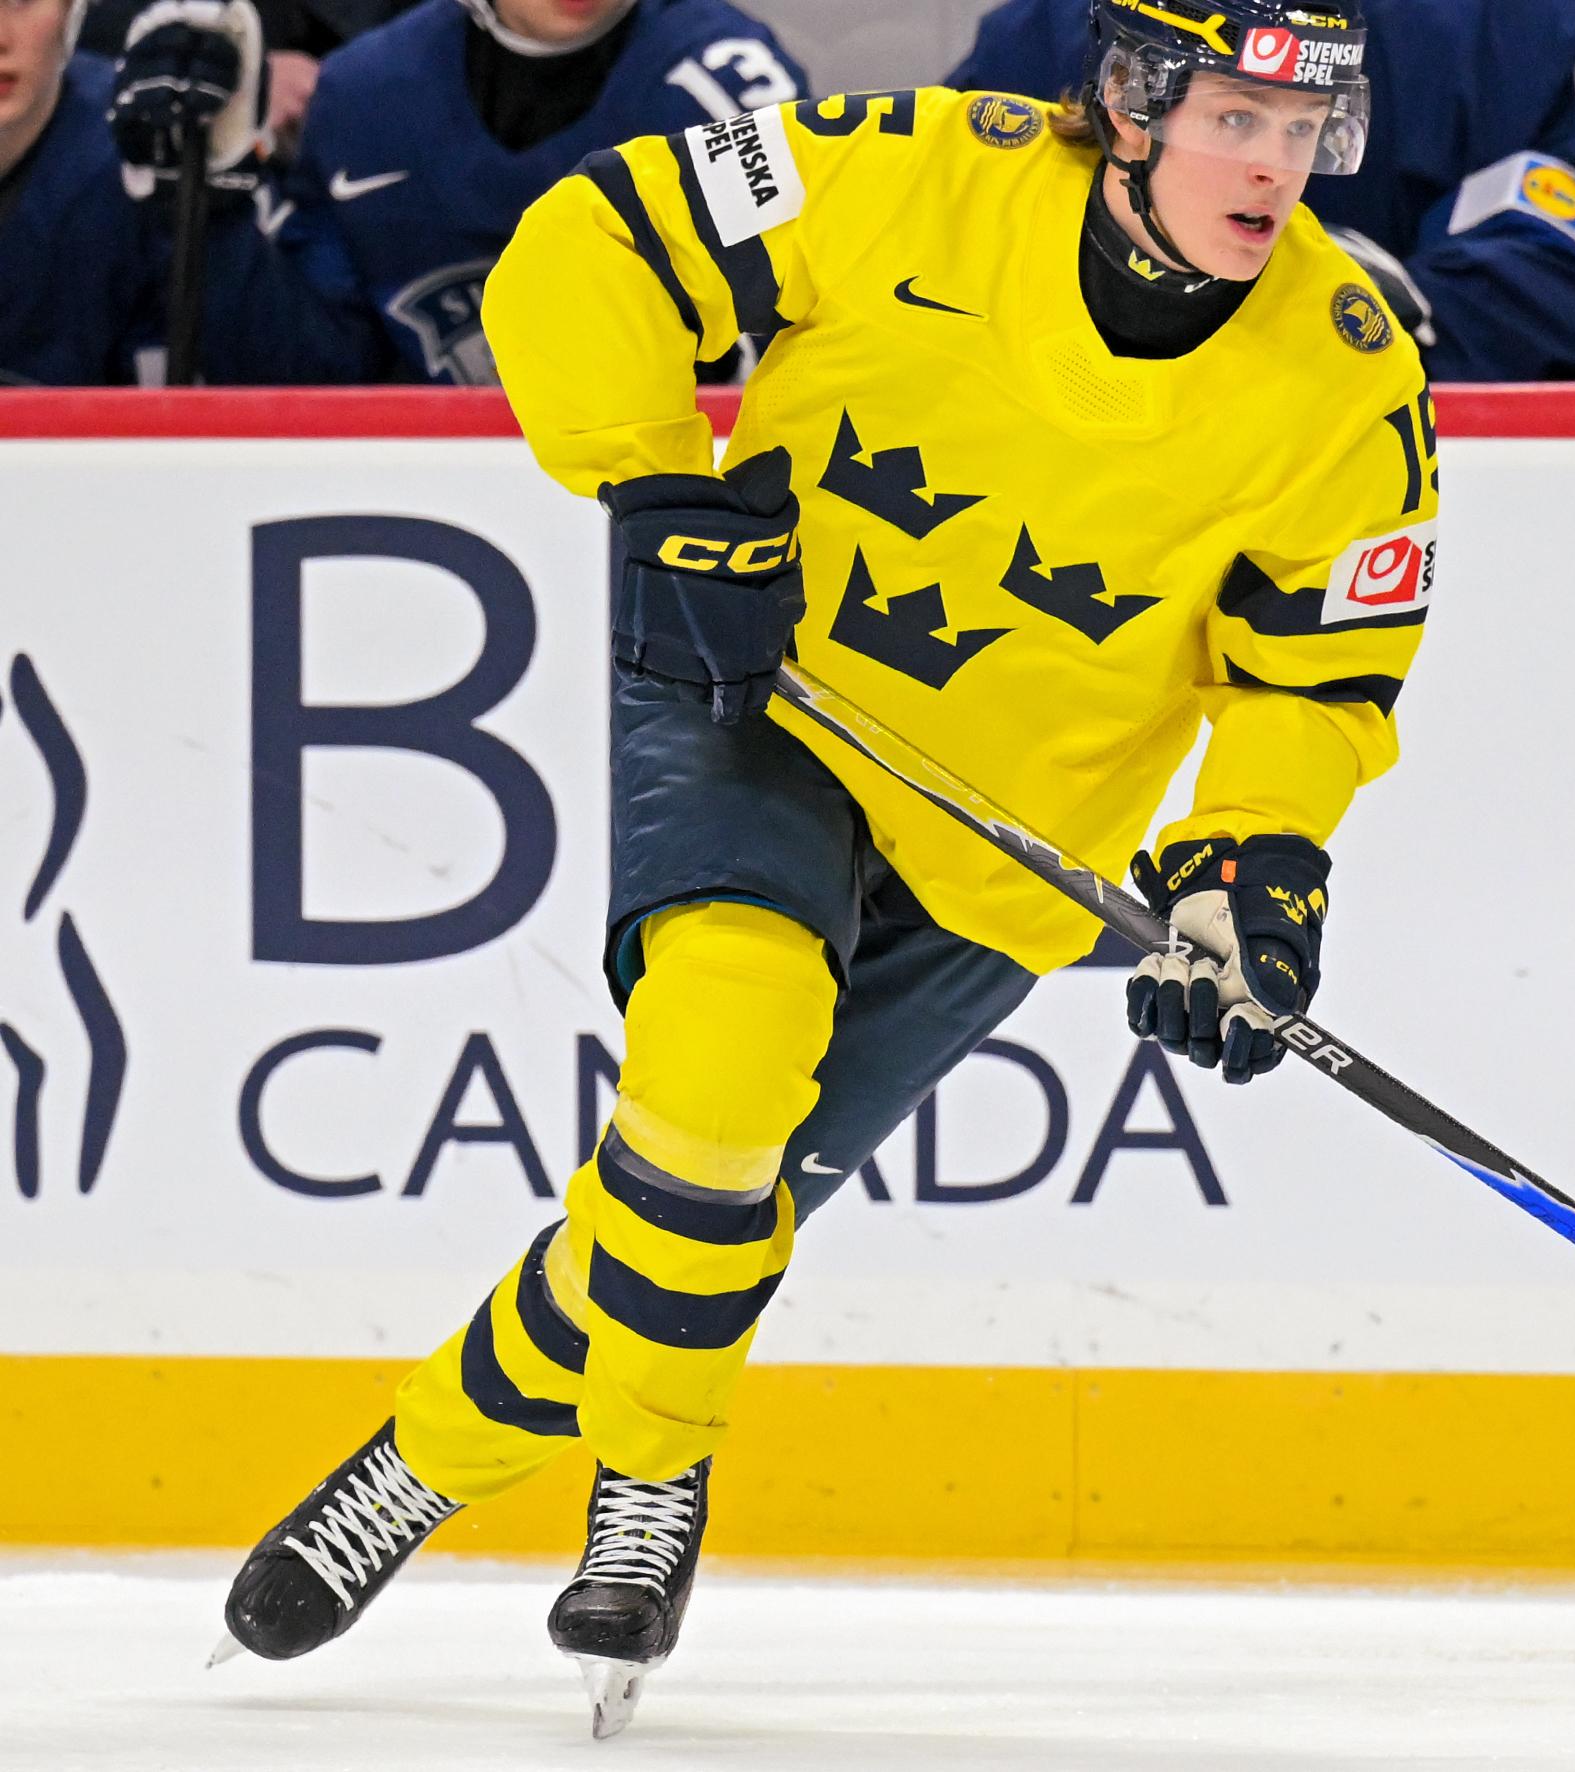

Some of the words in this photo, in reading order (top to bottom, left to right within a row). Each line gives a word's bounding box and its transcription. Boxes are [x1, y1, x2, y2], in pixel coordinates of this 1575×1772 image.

[665, 38, 798, 122] 13
[1292, 61, 1334, 86] SPEL
[702, 121, 733, 163] PEL
[729, 111, 779, 208] VENSKA
[1166, 843, 1213, 891] CCM
[237, 1027, 1230, 1207] CADA
